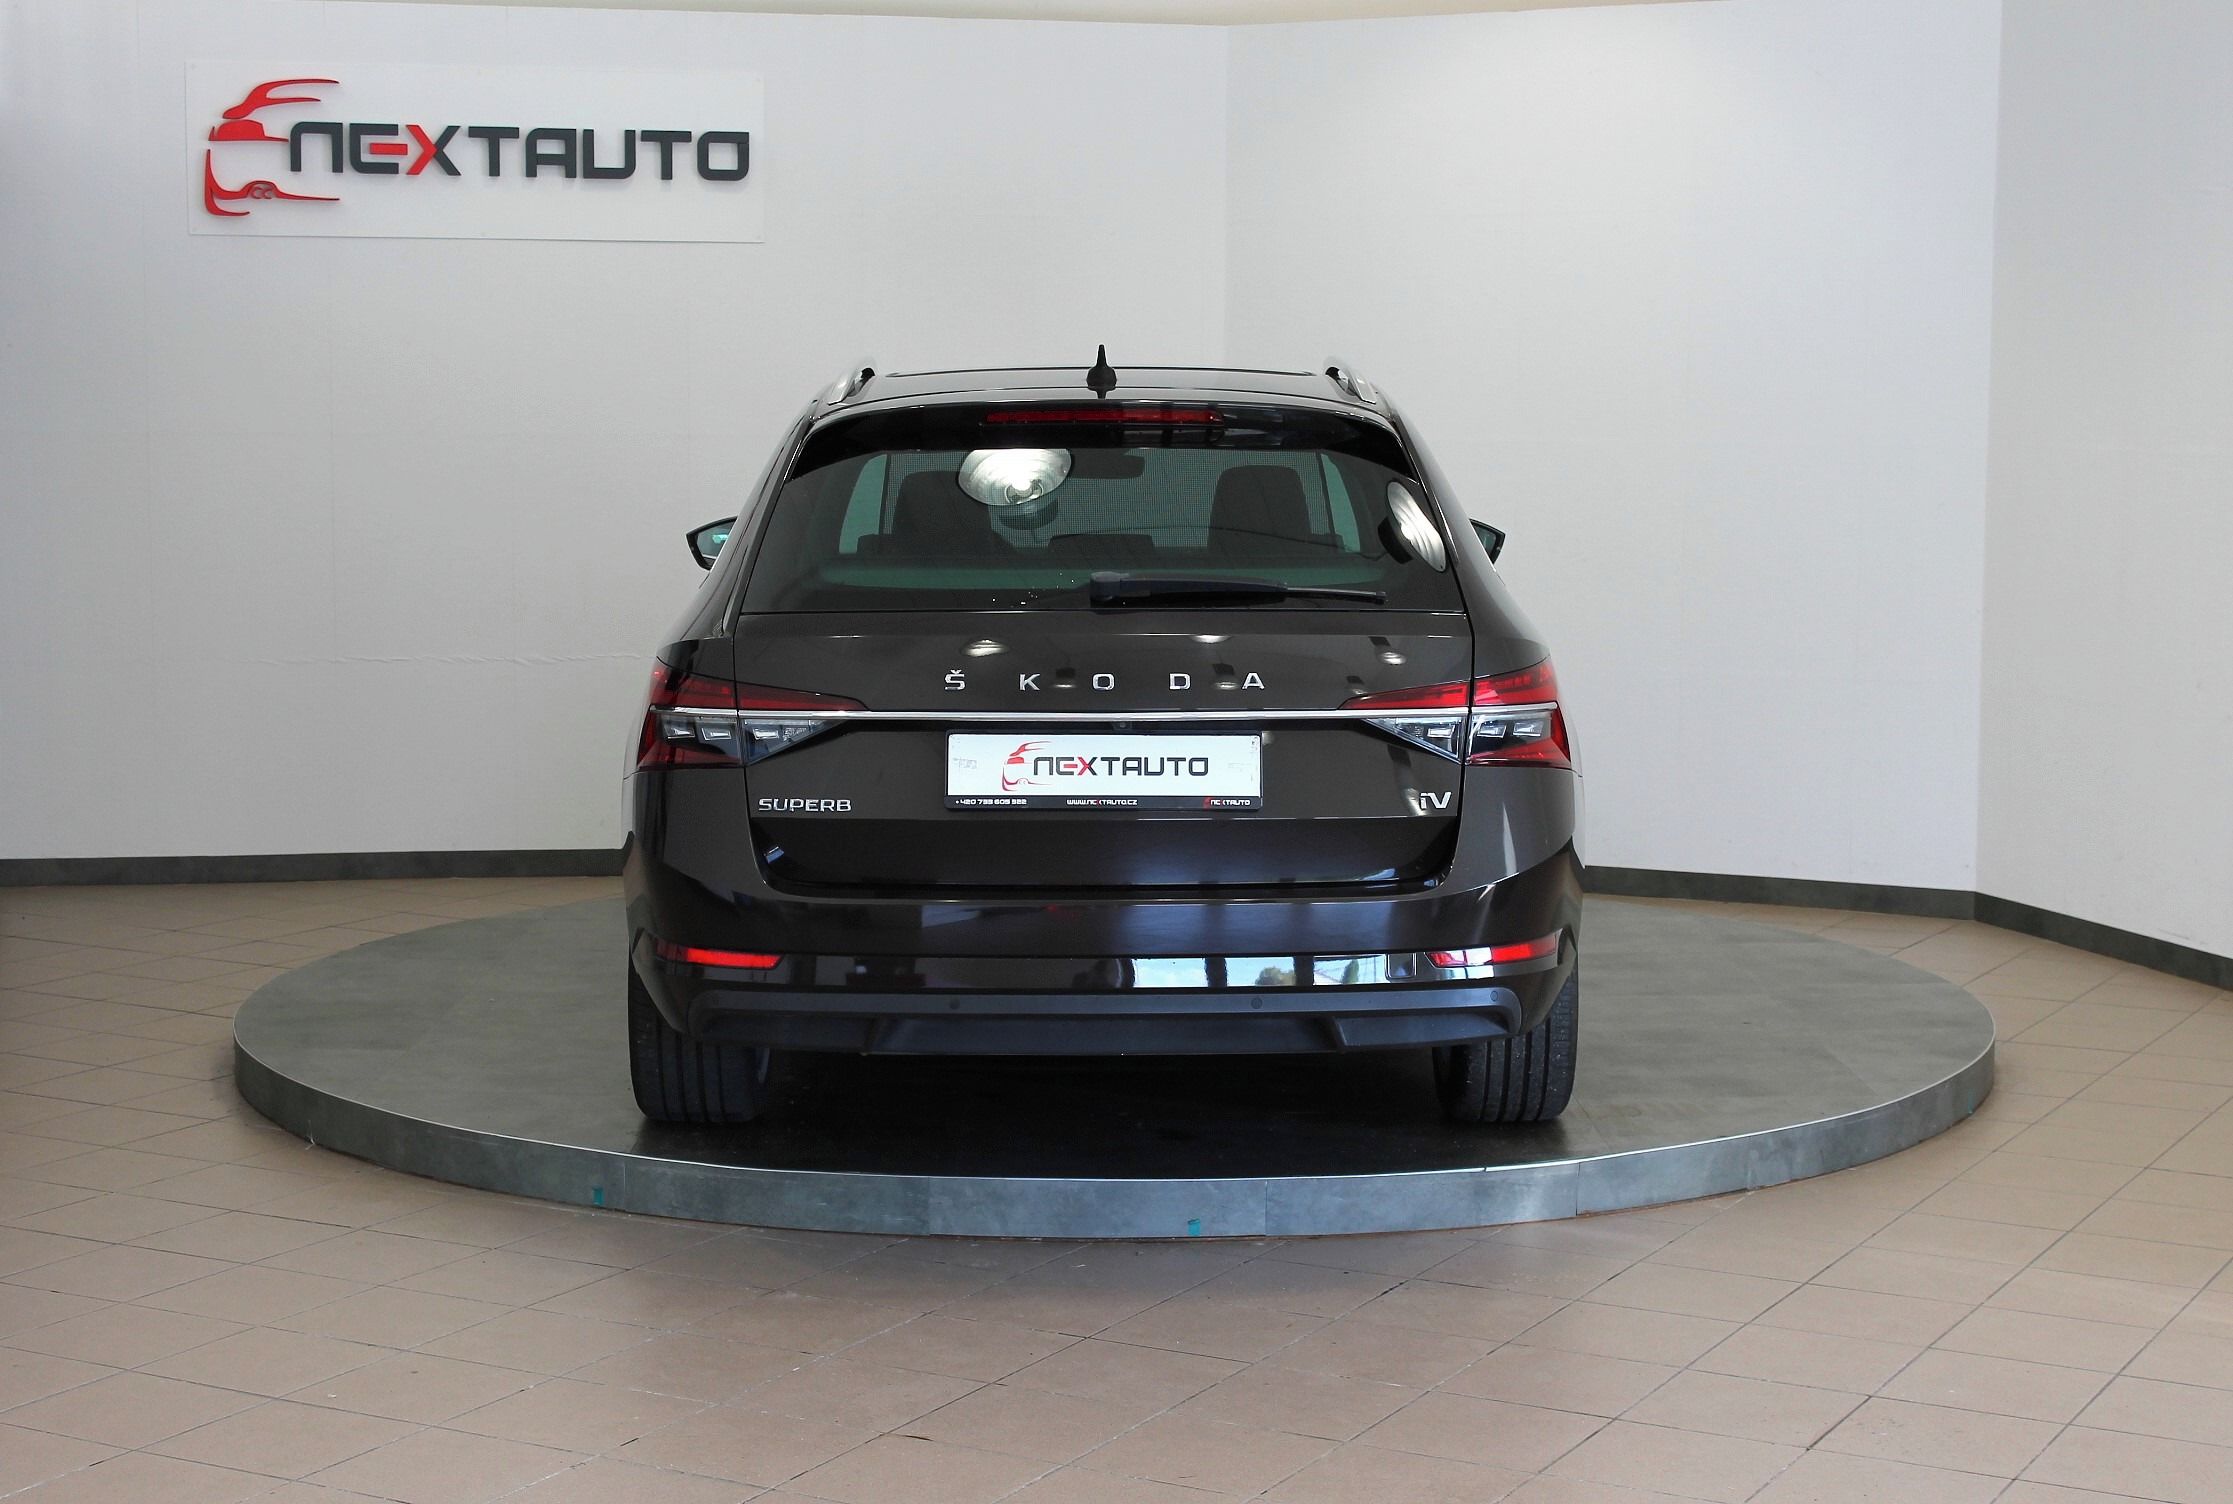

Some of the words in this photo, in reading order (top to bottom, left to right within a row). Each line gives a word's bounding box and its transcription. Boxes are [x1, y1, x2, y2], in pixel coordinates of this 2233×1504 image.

[289, 121, 750, 182] NEXTAUTO
[944, 669, 1265, 691] ŠKODA
[1033, 756, 1209, 777] NEXTAUTO
[758, 798, 852, 812] SUPERB
